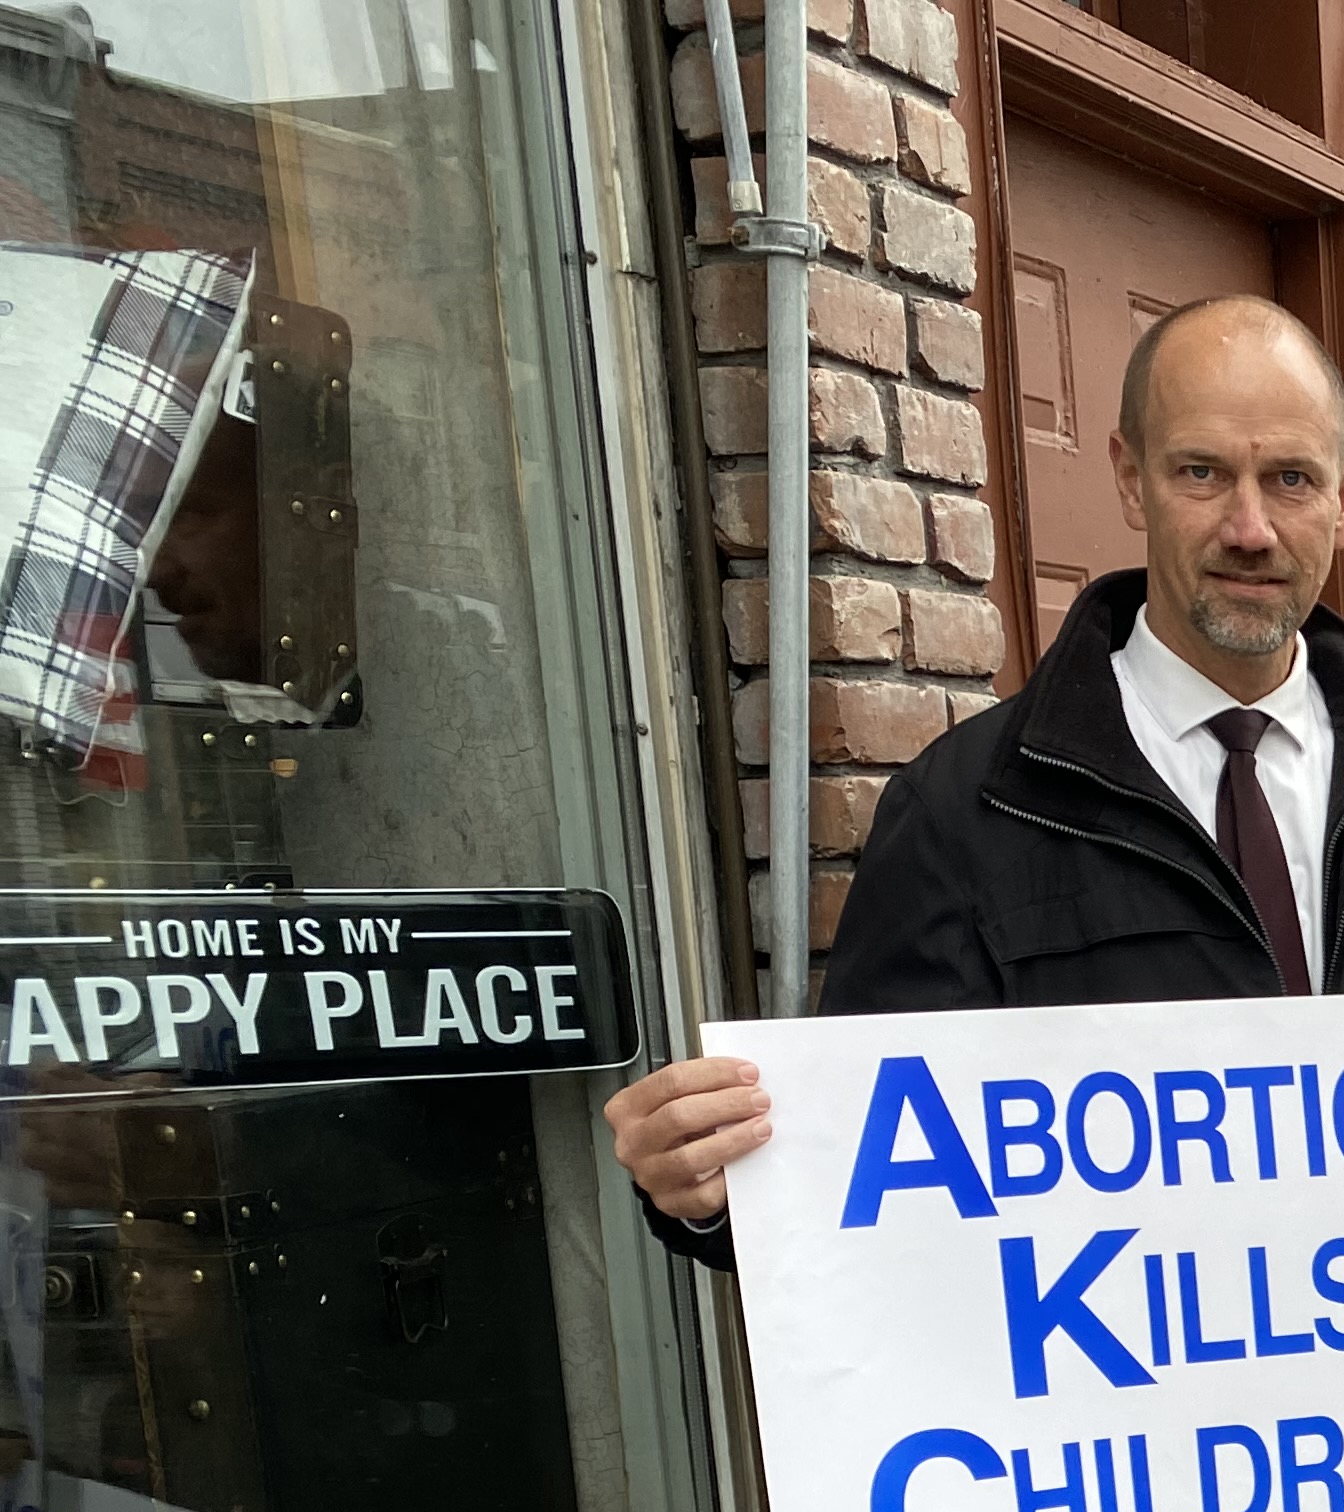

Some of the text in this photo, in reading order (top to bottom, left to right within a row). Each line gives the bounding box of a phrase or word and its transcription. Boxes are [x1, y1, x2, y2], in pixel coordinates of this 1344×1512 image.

[121, 917, 402, 958] HOME IS MY
[7, 965, 585, 1066] APPY PLACE
